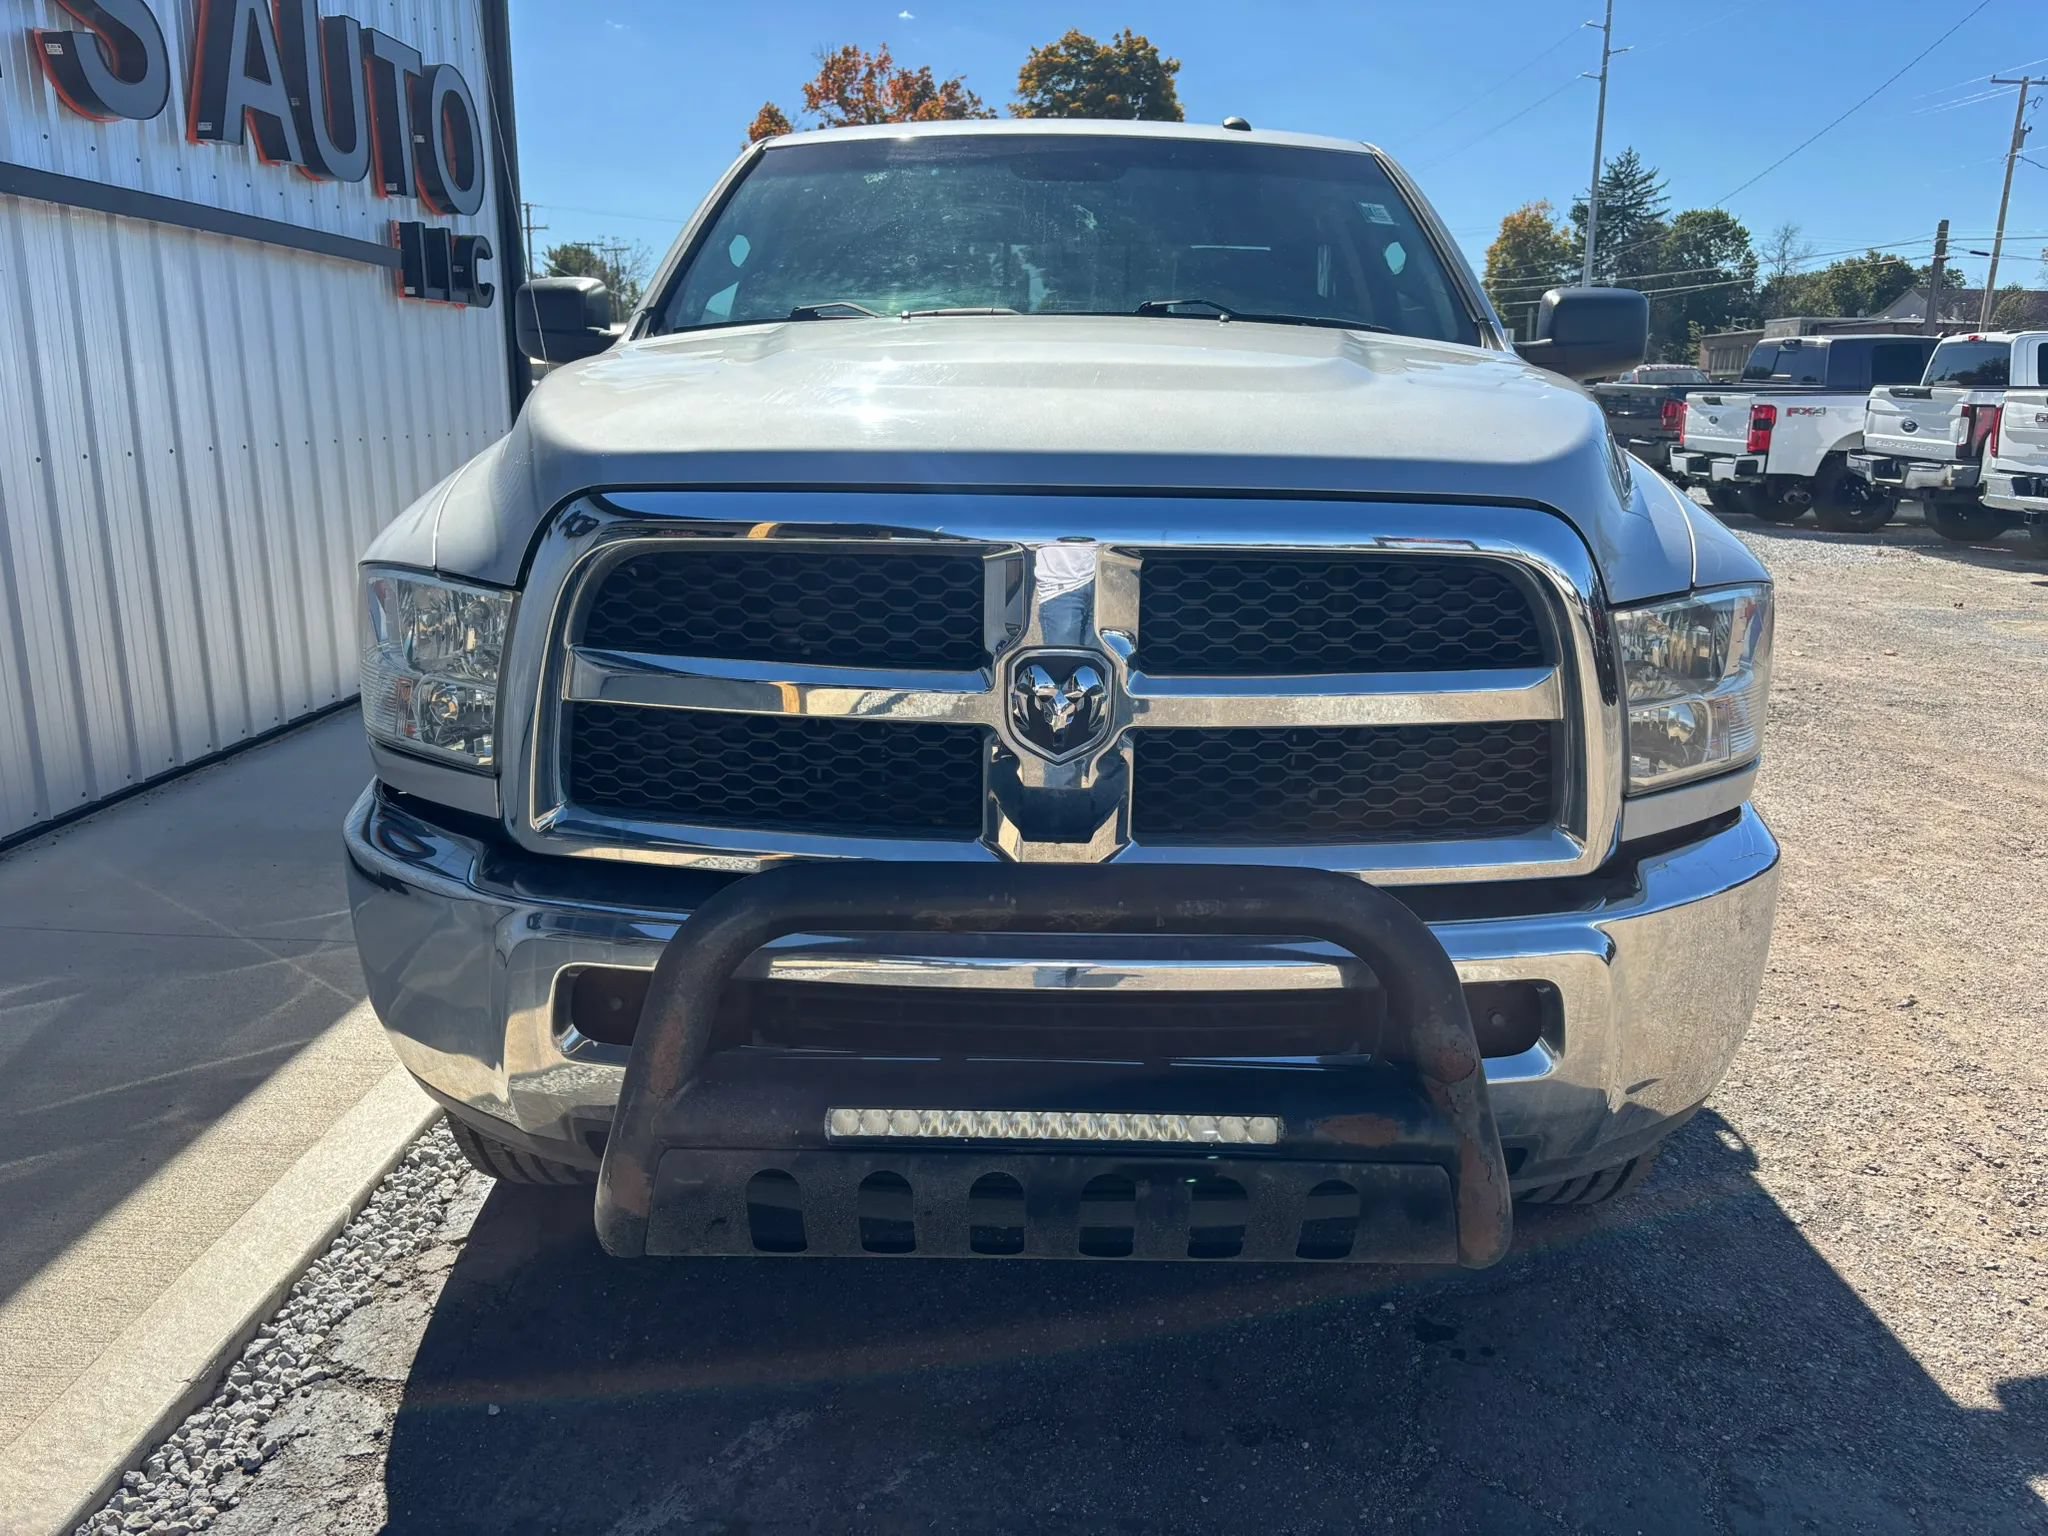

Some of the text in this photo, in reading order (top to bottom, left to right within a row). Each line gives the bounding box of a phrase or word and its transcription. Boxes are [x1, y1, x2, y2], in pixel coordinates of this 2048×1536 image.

[192, 0, 485, 216] AUTO
[397, 221, 495, 308] LLC
[1786, 406, 1827, 417] FX4
